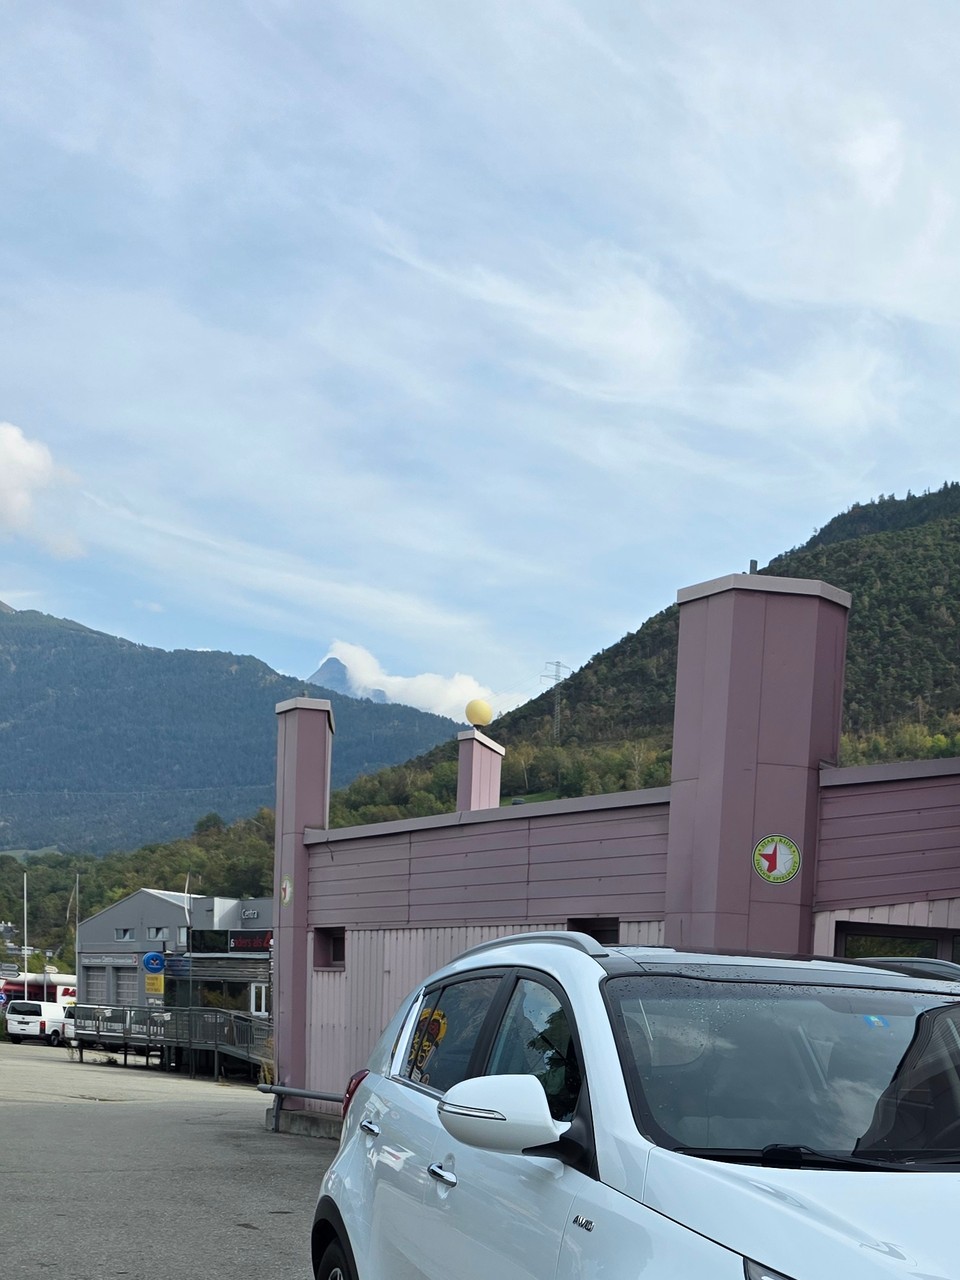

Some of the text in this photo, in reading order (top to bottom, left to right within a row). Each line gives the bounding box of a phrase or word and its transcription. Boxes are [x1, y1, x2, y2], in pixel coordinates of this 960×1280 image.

[760, 837, 794, 850] STAR KIDS
[755, 859, 798, 881] INDOOR SPIELPLATZ
